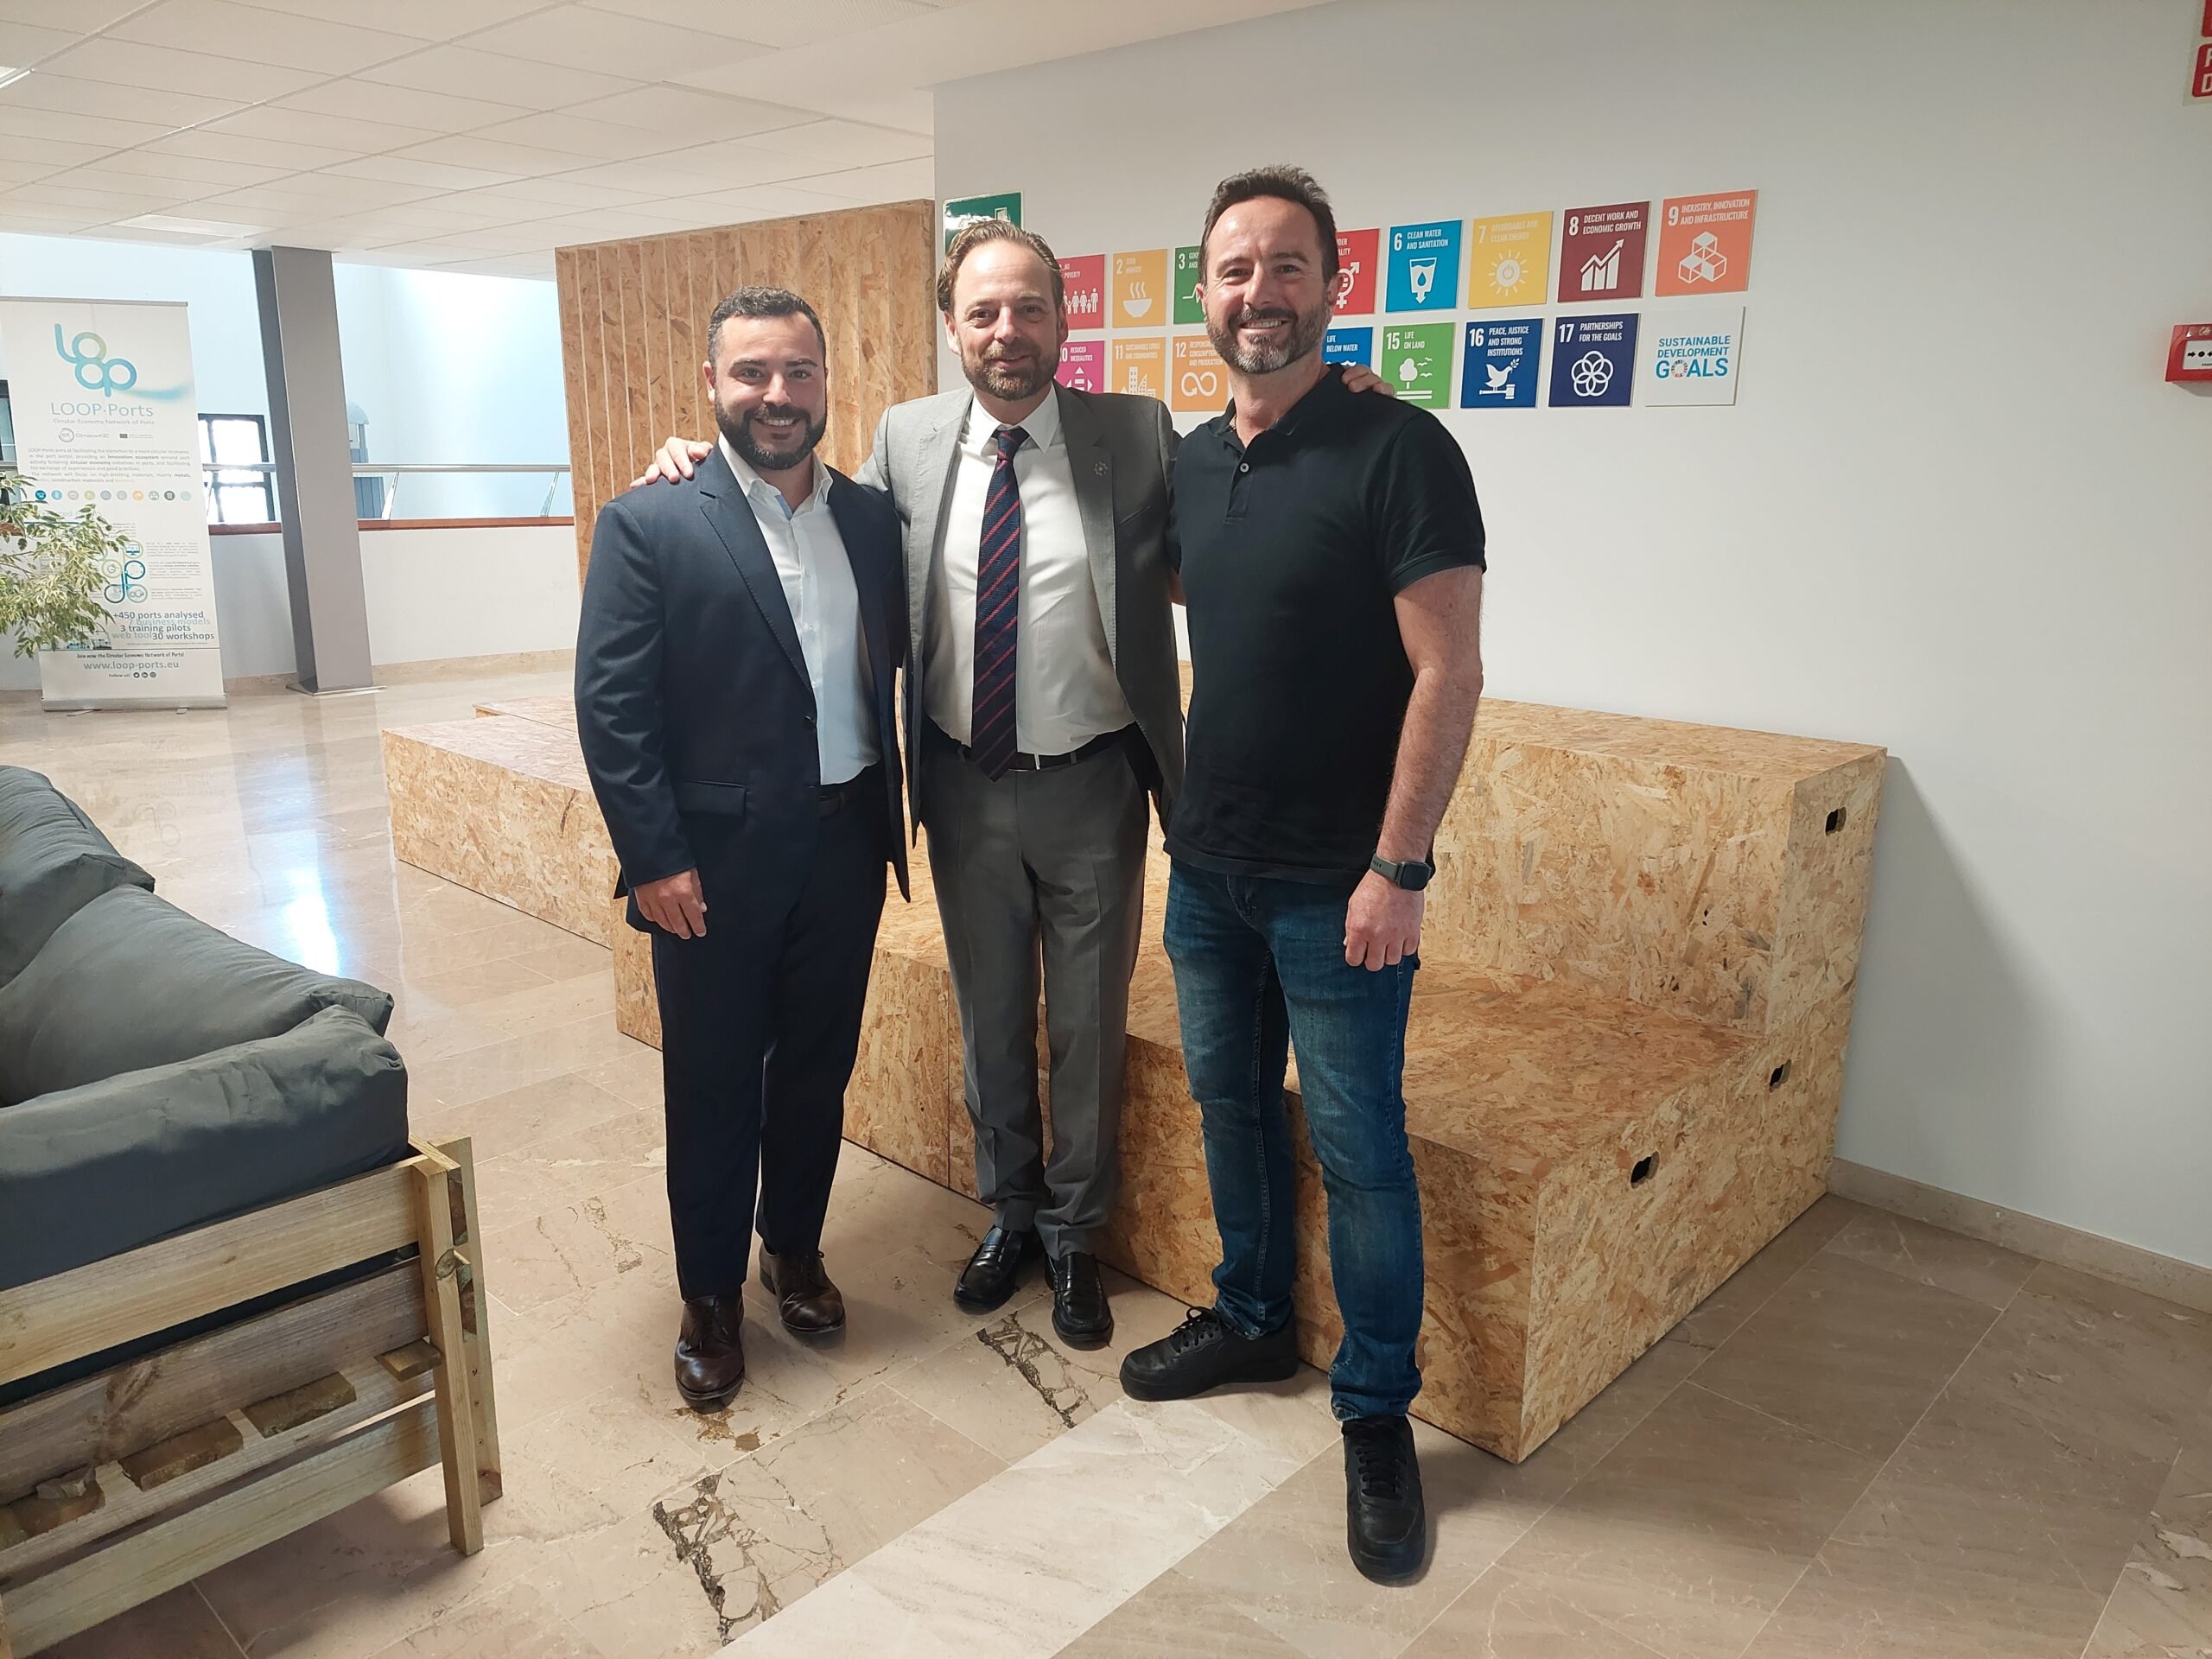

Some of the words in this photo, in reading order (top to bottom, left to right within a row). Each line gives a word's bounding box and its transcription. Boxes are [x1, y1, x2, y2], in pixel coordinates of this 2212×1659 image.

[1681, 202, 1712, 213] INDUSTRY,
[1713, 199, 1750, 210] INNOVATION
[1584, 213, 1605, 223] DECENT
[1607, 212, 1624, 221] WORK
[1625, 210, 1638, 219] AND
[1669, 206, 1679, 226] 9
[1681, 216, 1694, 225] AND
[1694, 210, 1748, 224] INFRASTRUCTURE
[1569, 217, 1579, 236] 8
[1583, 225, 1613, 234] ECONOMIC
[1615, 221, 1641, 232] GROWTH
[1408, 231, 1423, 239] CLEAN
[1424, 229, 1441, 238] WATER
[1479, 226, 1486, 244] 7
[1394, 233, 1402, 251] 6
[1418, 239, 1448, 248] SANITATION
[1116, 259, 1122, 275] 2
[1179, 253, 1185, 270] 3
[1508, 326, 1529, 334] JUSTICE
[1580, 321, 1623, 331] PARTNERSHIPS
[1470, 328, 1484, 346] 16
[1559, 324, 1574, 342] 17
[1603, 333, 1622, 341] GOALS
[1386, 333, 1400, 349] 15
[1659, 335, 1731, 347] SUSTAINABLE
[1115, 346, 1122, 359] 11
[1175, 341, 1186, 358] 12
[1487, 348, 1522, 357] INSTITUTIONS
[1657, 346, 1729, 358] DEVELOPMENT
[1656, 358, 1728, 378] GOALS
[138, 612, 162, 621] ports
[164, 611, 203, 620] analysed
[129, 625, 163, 633] training
[167, 624, 191, 632] pilots
[84, 661, 179, 670] www.loop-ports.eu
